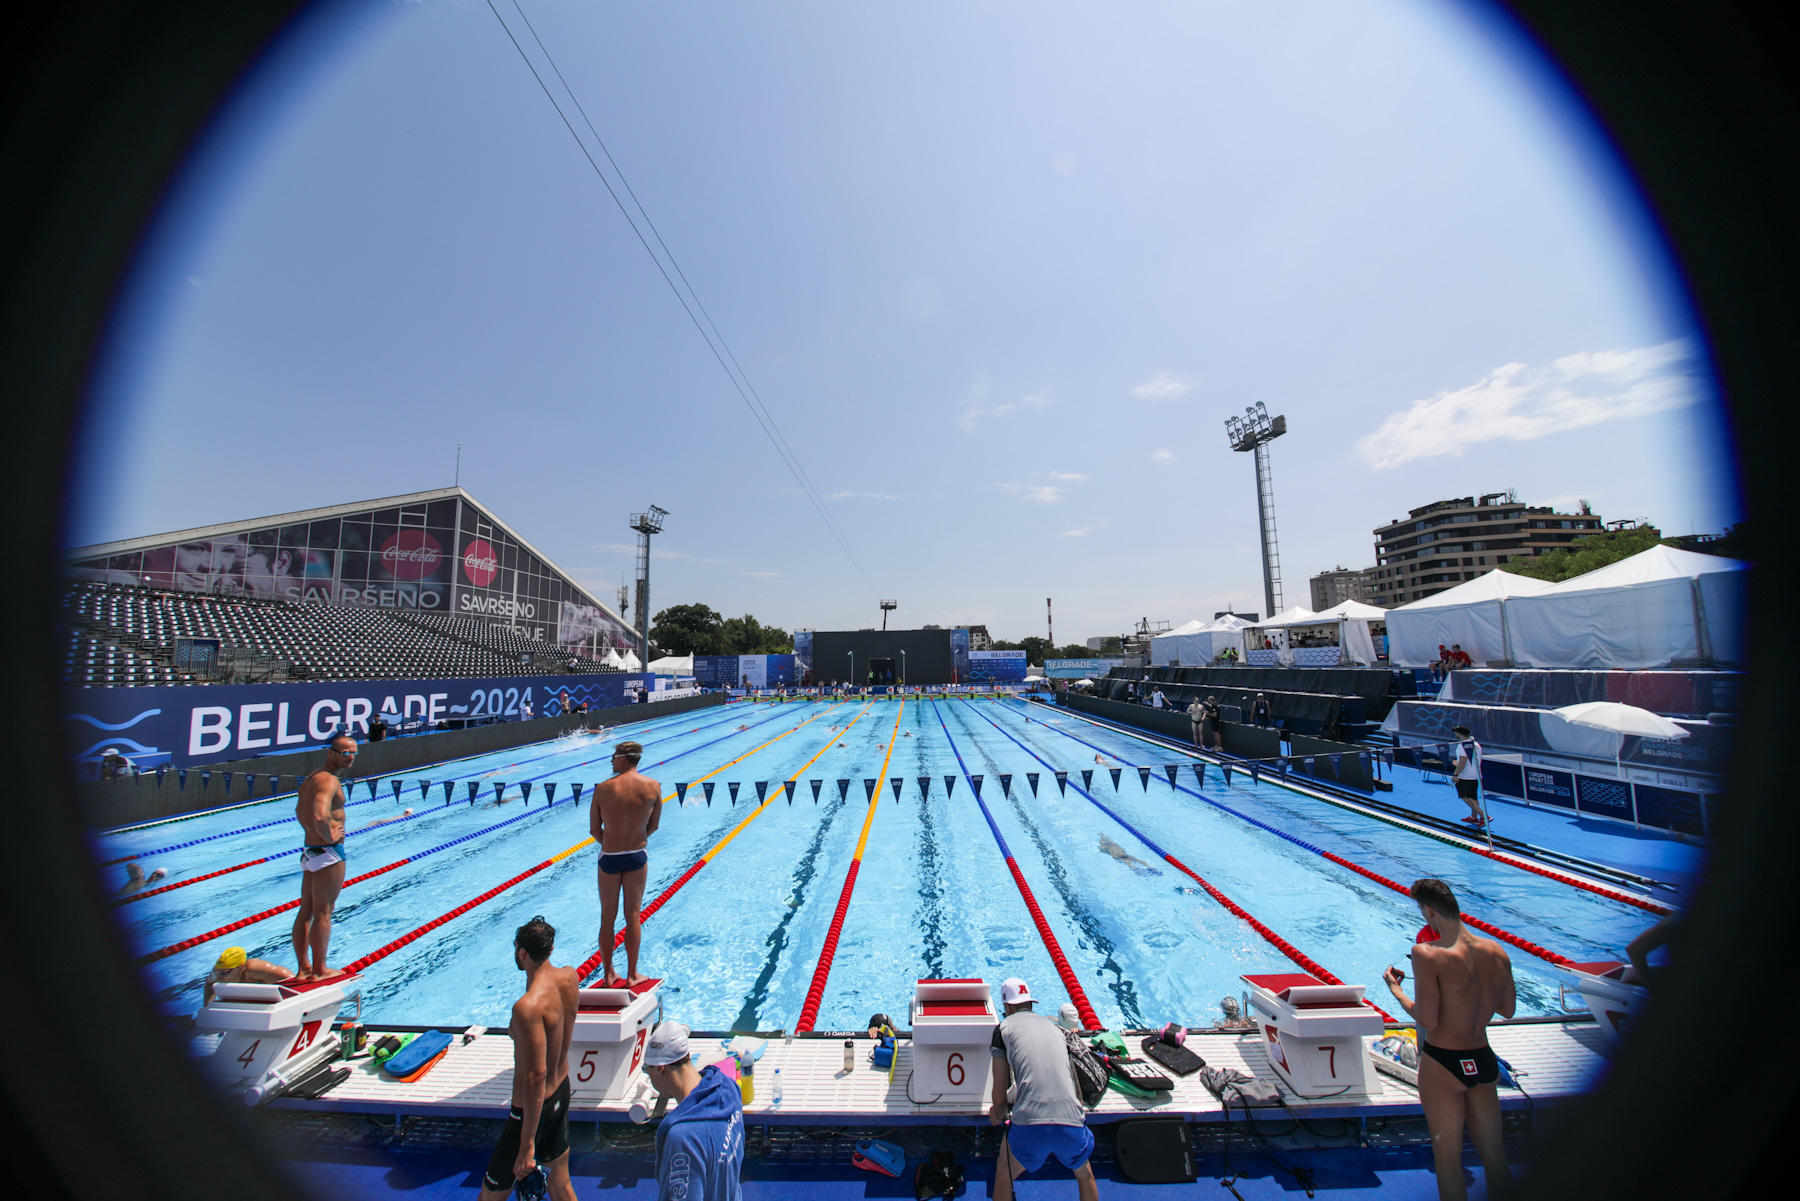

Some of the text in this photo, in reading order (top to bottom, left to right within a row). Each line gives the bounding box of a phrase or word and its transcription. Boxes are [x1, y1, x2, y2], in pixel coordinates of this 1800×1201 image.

[382, 545, 440, 563] Coca-Cola
[465, 553, 497, 572] Coca-Cola
[460, 593, 535, 618] SAVRŠENO
[297, 1030, 310, 1049] 4
[635, 1037, 642, 1060] 5
[237, 1039, 261, 1069] 4
[577, 1050, 598, 1082] 5
[1318, 1046, 1336, 1078] 7
[947, 1052, 965, 1086] 6
